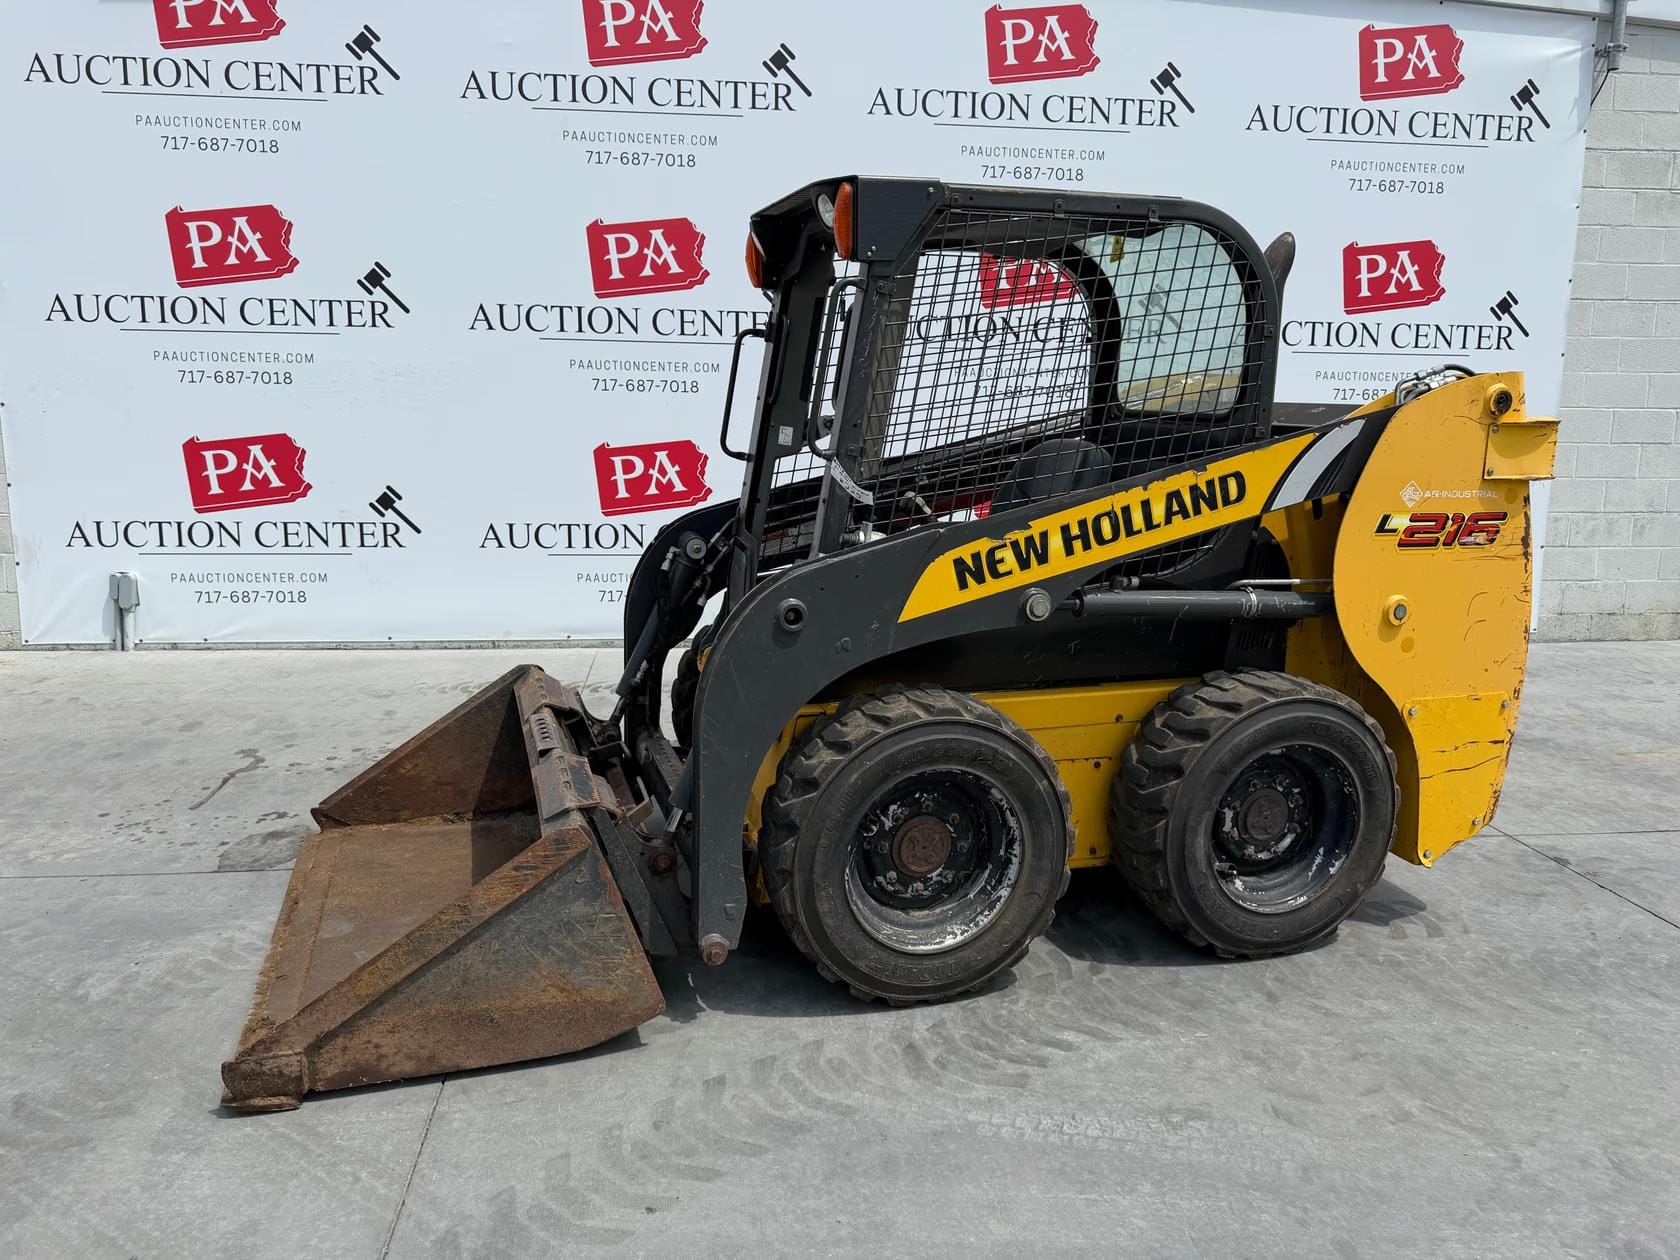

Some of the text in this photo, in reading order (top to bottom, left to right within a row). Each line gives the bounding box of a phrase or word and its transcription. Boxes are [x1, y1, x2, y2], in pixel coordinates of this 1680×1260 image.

[599, 0, 681, 47] PA
[1000, 16, 1075, 65] PA
[1372, 35, 1441, 82] PA
[24, 53, 384, 95] AUCTION CENTER
[460, 70, 797, 111] AUCTION CENTER
[867, 87, 1180, 127] AUCTION CENTER
[136, 115, 301, 131] PAAUCTIONCENTER.COM
[1245, 103, 1535, 142] AUCTION CENTER
[161, 136, 279, 153] 717-687-7018
[563, 130, 717, 146] PAAUCTIONCENTER.COM
[585, 151, 695, 167] 717-687-7018
[961, 145, 1104, 160] PAAUCTIONCENTER.COM
[981, 165, 1083, 181] 717-687-7018
[1331, 160, 1464, 174] PAAUCTIONCENTER.COM
[1349, 179, 1444, 194] 717-687-7018
[184, 216, 271, 268] PA
[604, 229, 683, 279] PA
[1356, 251, 1423, 297] PA
[45, 294, 395, 328] AUCTION CENTER
[469, 303, 768, 337] AUCTION CENTE
[1282, 321, 1515, 350] CTION CENTER
[153, 351, 314, 363] PAAUCTIONCENTER.COM
[570, 359, 719, 373] PAAUCTIONCENTER.COM
[178, 370, 292, 384] 717-687-7018
[592, 378, 699, 393] 717-687-7018
[1315, 371, 1412, 382] PAAUCTIONCENTE
[1333, 388, 1387, 401] 717-687
[201, 445, 284, 494] PA
[611, 451, 687, 498] PA
[66, 521, 406, 548] AUCTION CENTER
[479, 523, 646, 549] AUCTION
[953, 471, 1246, 591] NEW HOLLAND
[171, 573, 327, 583] PAAUCTIONCENTER.COM
[195, 591, 306, 603] 717-687-7018
